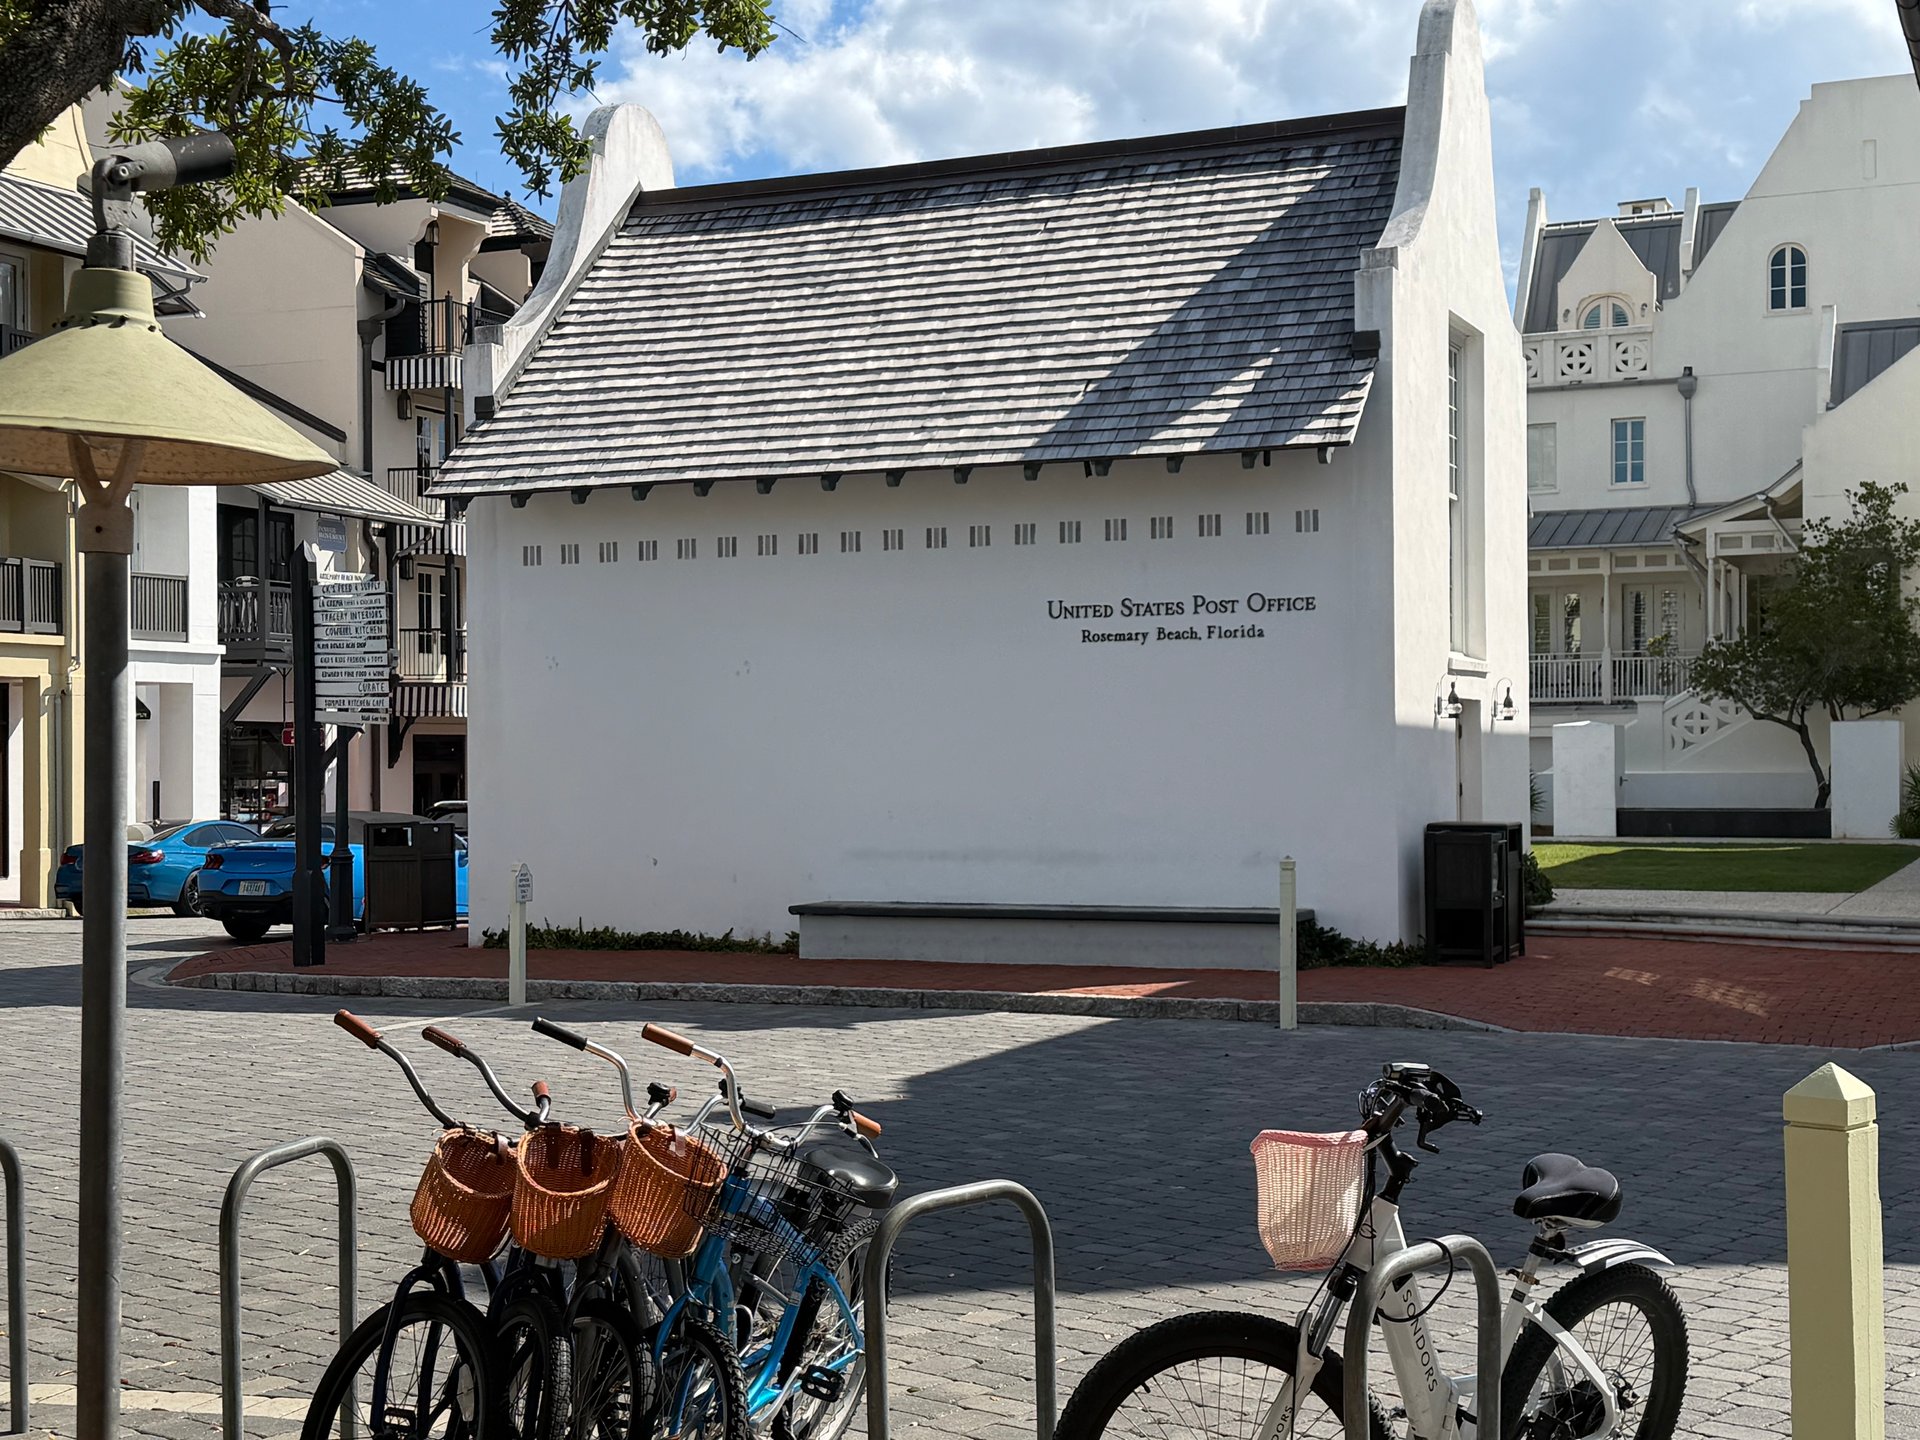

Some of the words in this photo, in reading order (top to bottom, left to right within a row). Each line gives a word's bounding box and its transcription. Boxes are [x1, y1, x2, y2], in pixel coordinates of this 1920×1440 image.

[338, 583, 352, 593] FEED
[361, 581, 380, 591] SUPPLY
[350, 610, 383, 620] INTERIORS
[355, 624, 383, 635] KITCHEN
[1081, 629, 1149, 645] Rosemary
[1207, 624, 1265, 639] Florida
[358, 683, 384, 692] CURATE
[1403, 1289, 1438, 1392] SONDORS
